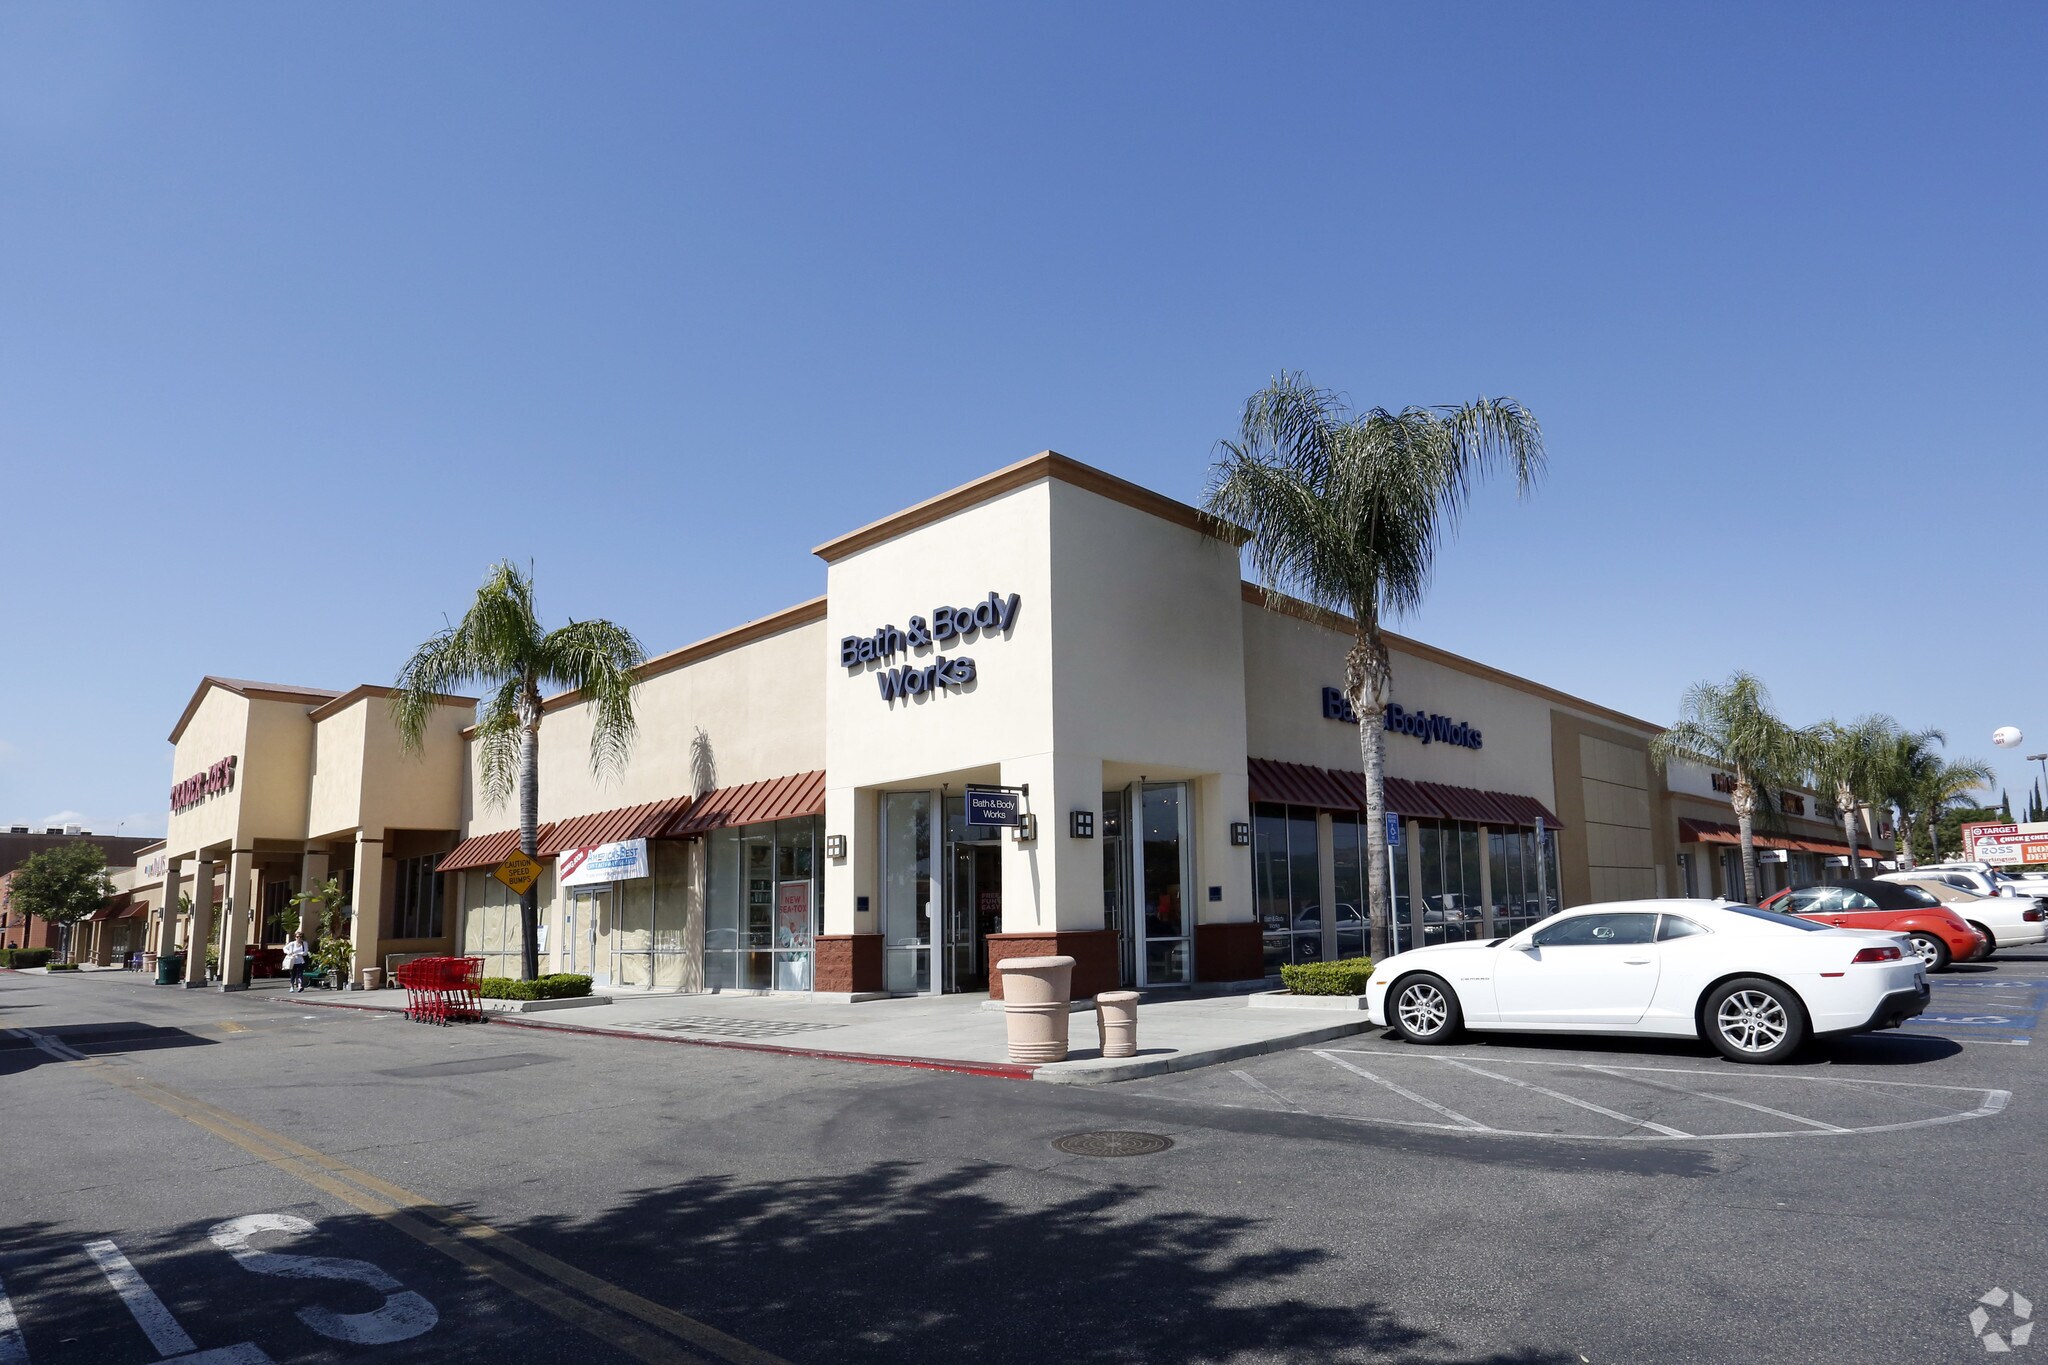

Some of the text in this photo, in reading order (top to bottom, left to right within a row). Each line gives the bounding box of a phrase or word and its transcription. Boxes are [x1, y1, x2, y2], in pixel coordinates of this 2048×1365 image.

[841, 591, 1021, 668] Bath & Body
[877, 655, 976, 702] Works
[1322, 687, 1357, 724] Ba
[1387, 703, 1434, 744] Body
[1430, 714, 1483, 749] Works
[170, 755, 238, 812] TRADER JOE'S
[972, 799, 1015, 810] Bath & Body
[983, 810, 1006, 819] Works
[1982, 846, 2014, 854] ROSS
[504, 859, 531, 869] CAUTION
[508, 868, 530, 876] SPEED
[509, 875, 532, 885] BUMPS
[785, 896, 801, 904] NEW
